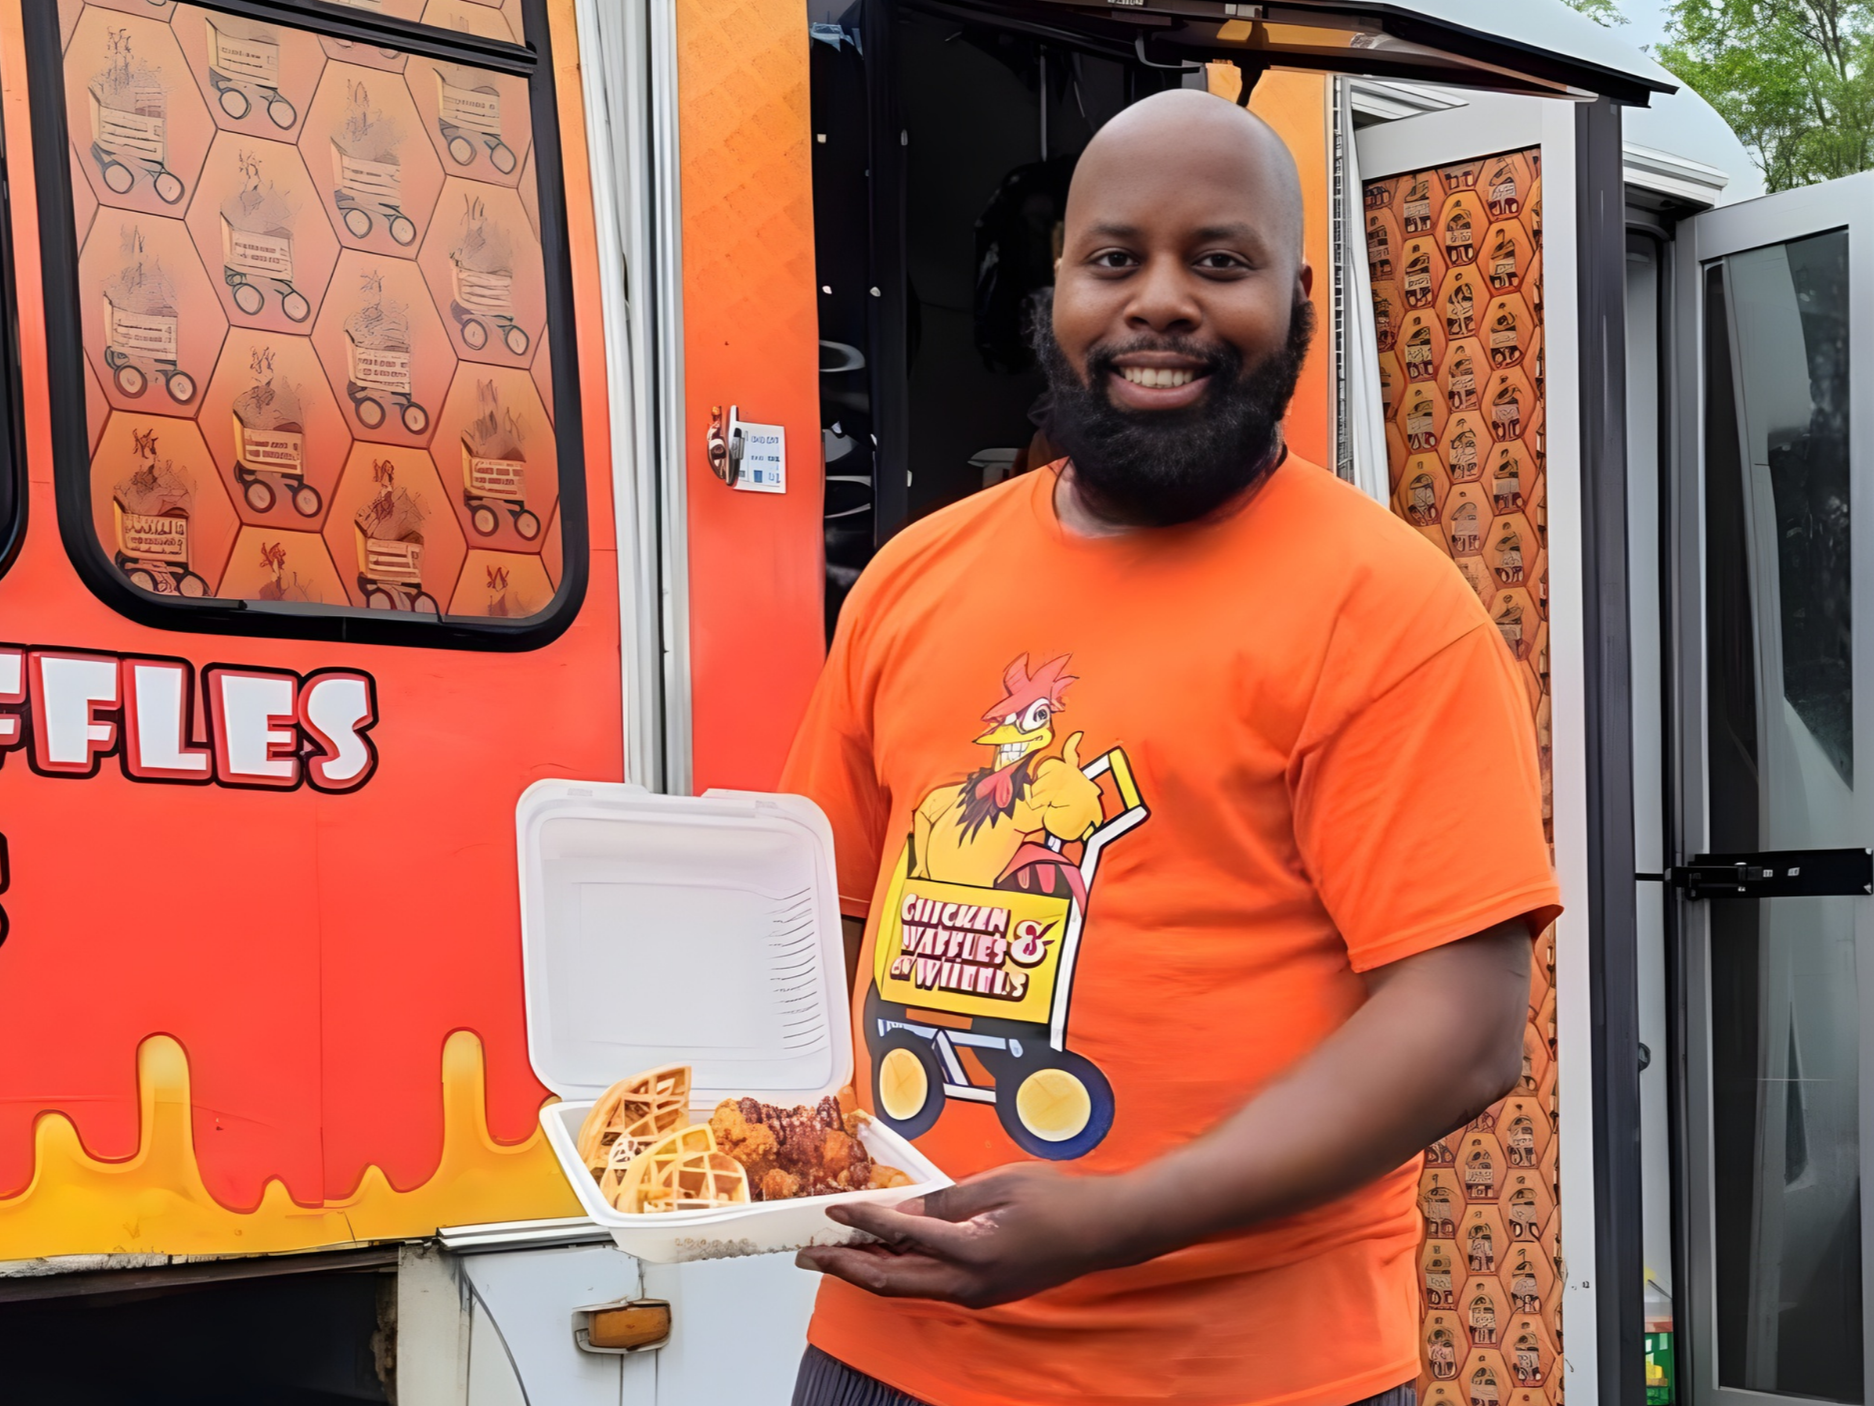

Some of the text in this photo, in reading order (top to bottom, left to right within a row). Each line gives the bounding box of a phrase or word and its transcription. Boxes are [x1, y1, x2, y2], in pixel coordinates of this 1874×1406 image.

[0, 647, 376, 790] FLES
[902, 920, 1050, 967] WAFFLES &
